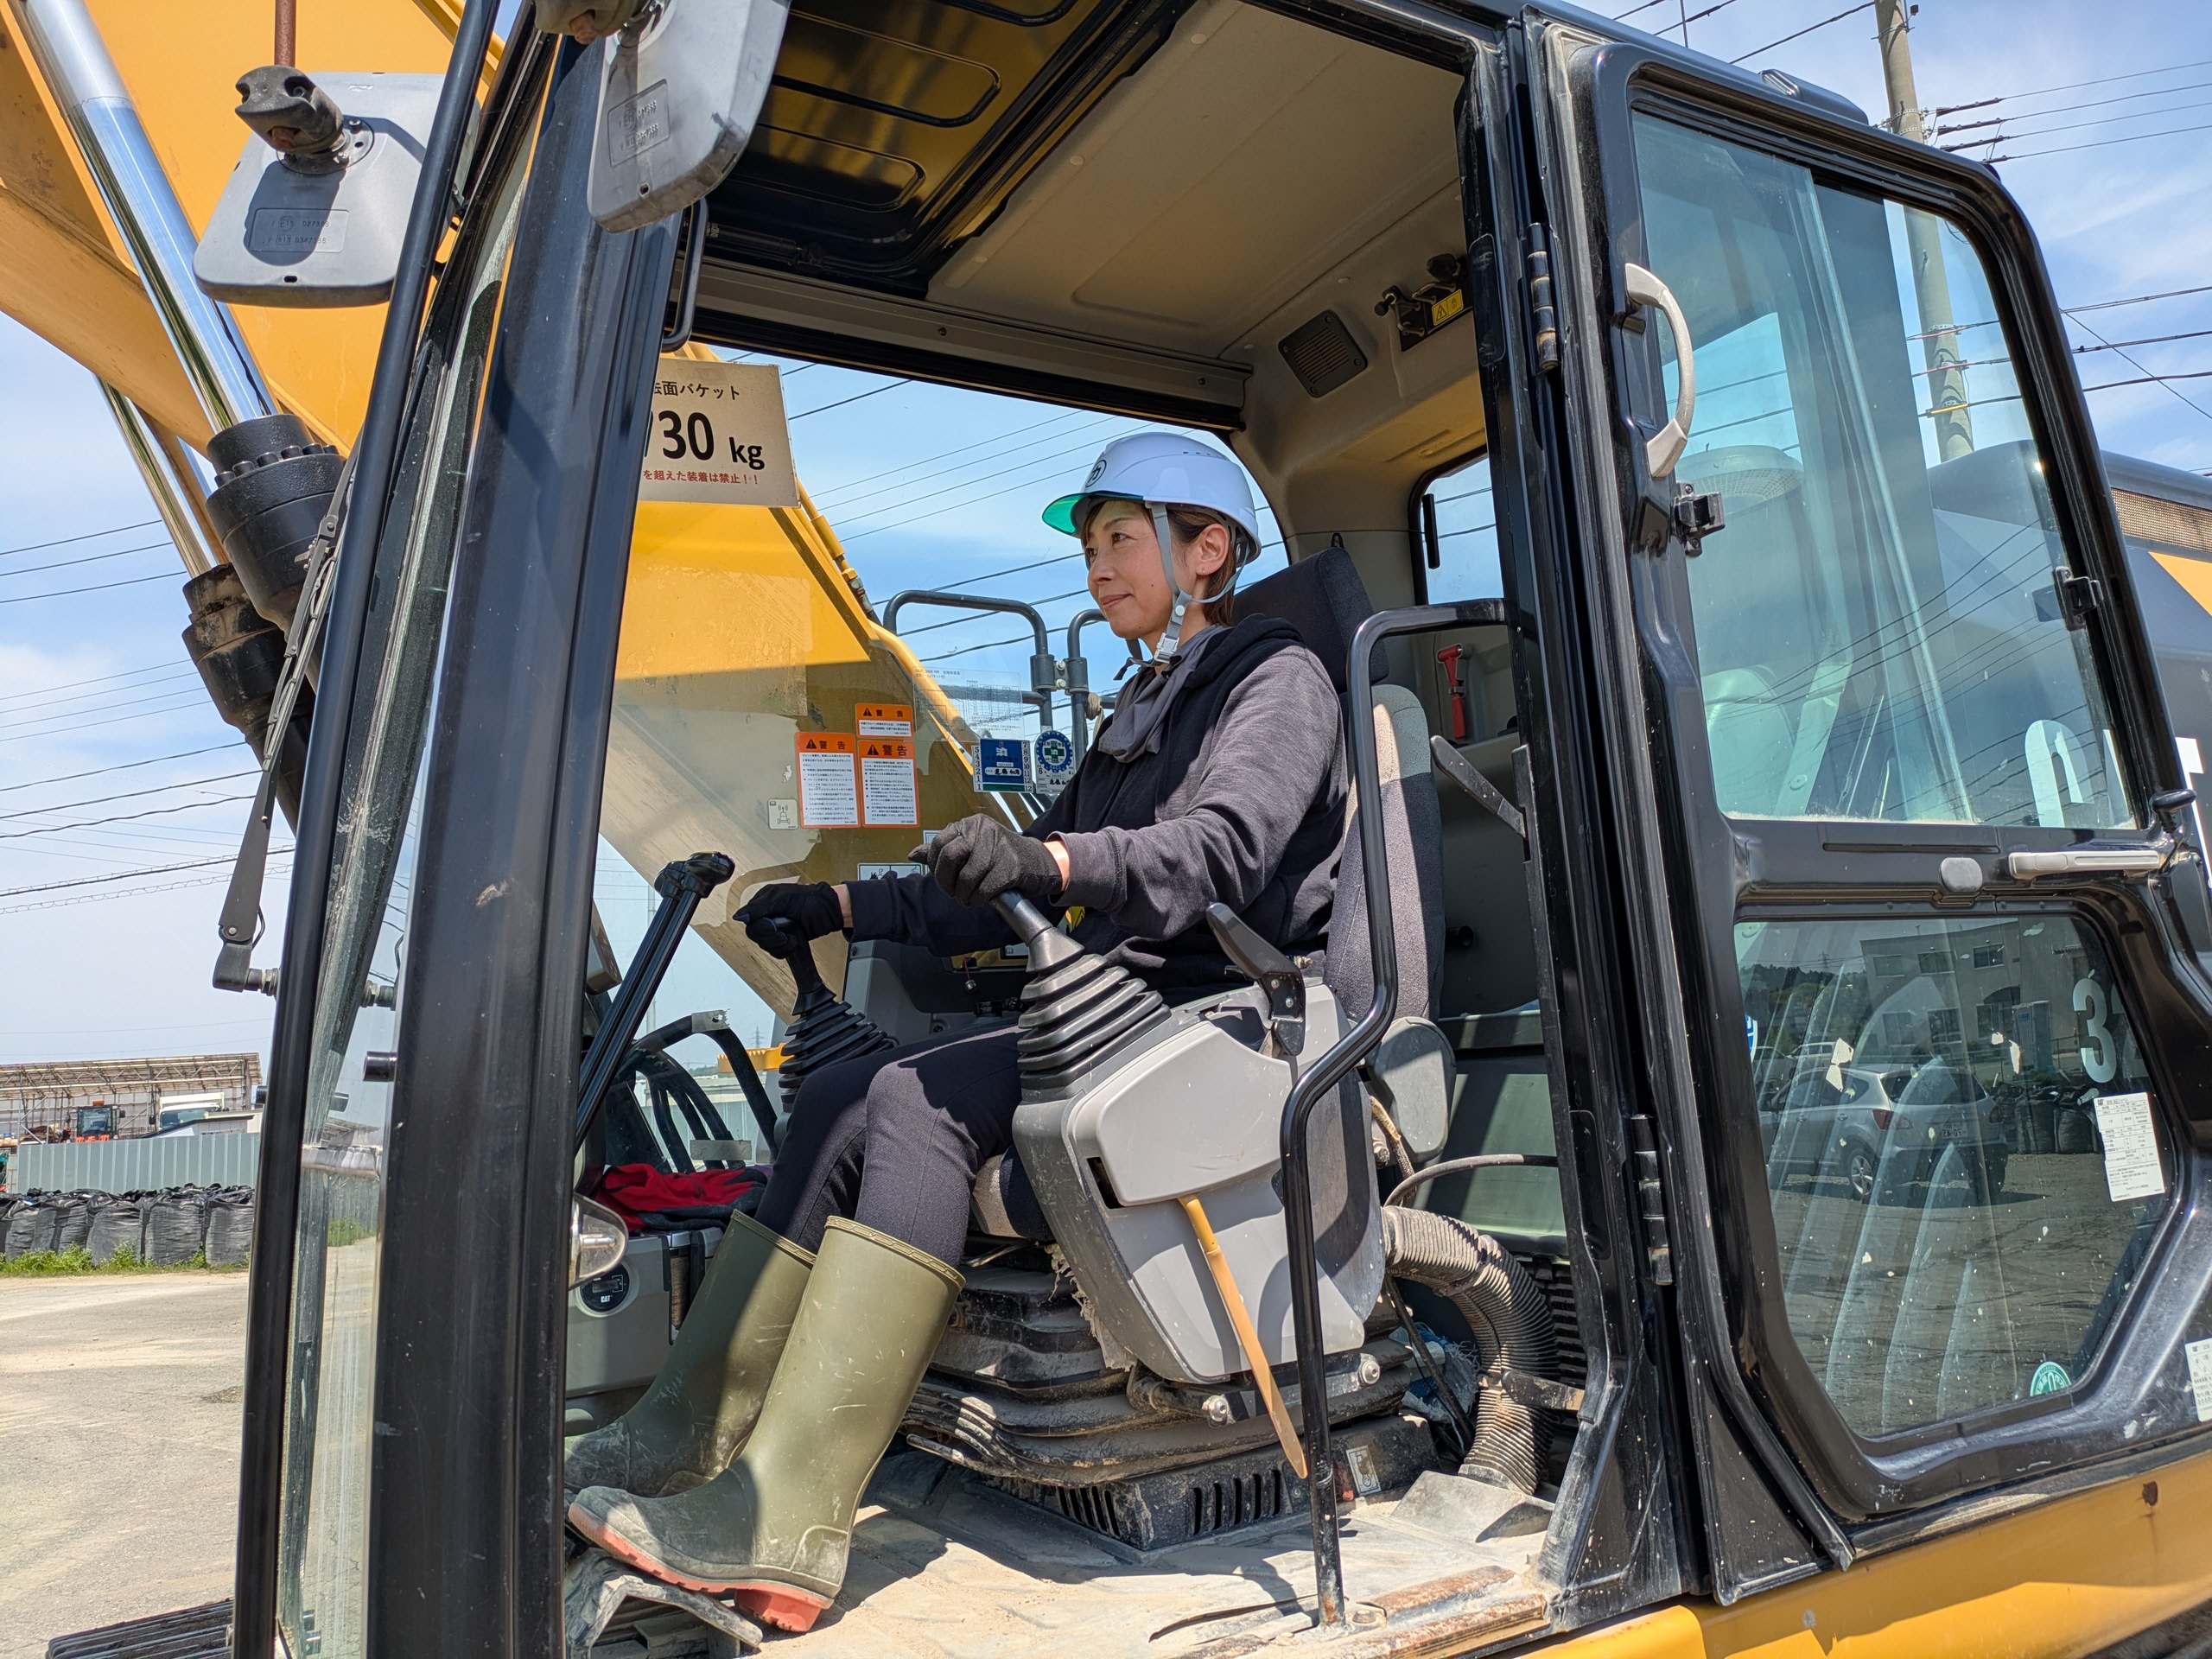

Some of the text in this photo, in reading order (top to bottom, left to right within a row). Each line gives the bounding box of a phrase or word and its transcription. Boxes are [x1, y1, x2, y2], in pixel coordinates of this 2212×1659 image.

[728, 436, 766, 471] kg
[819, 741, 846, 750] 警告
[882, 744, 908, 756] 警告
